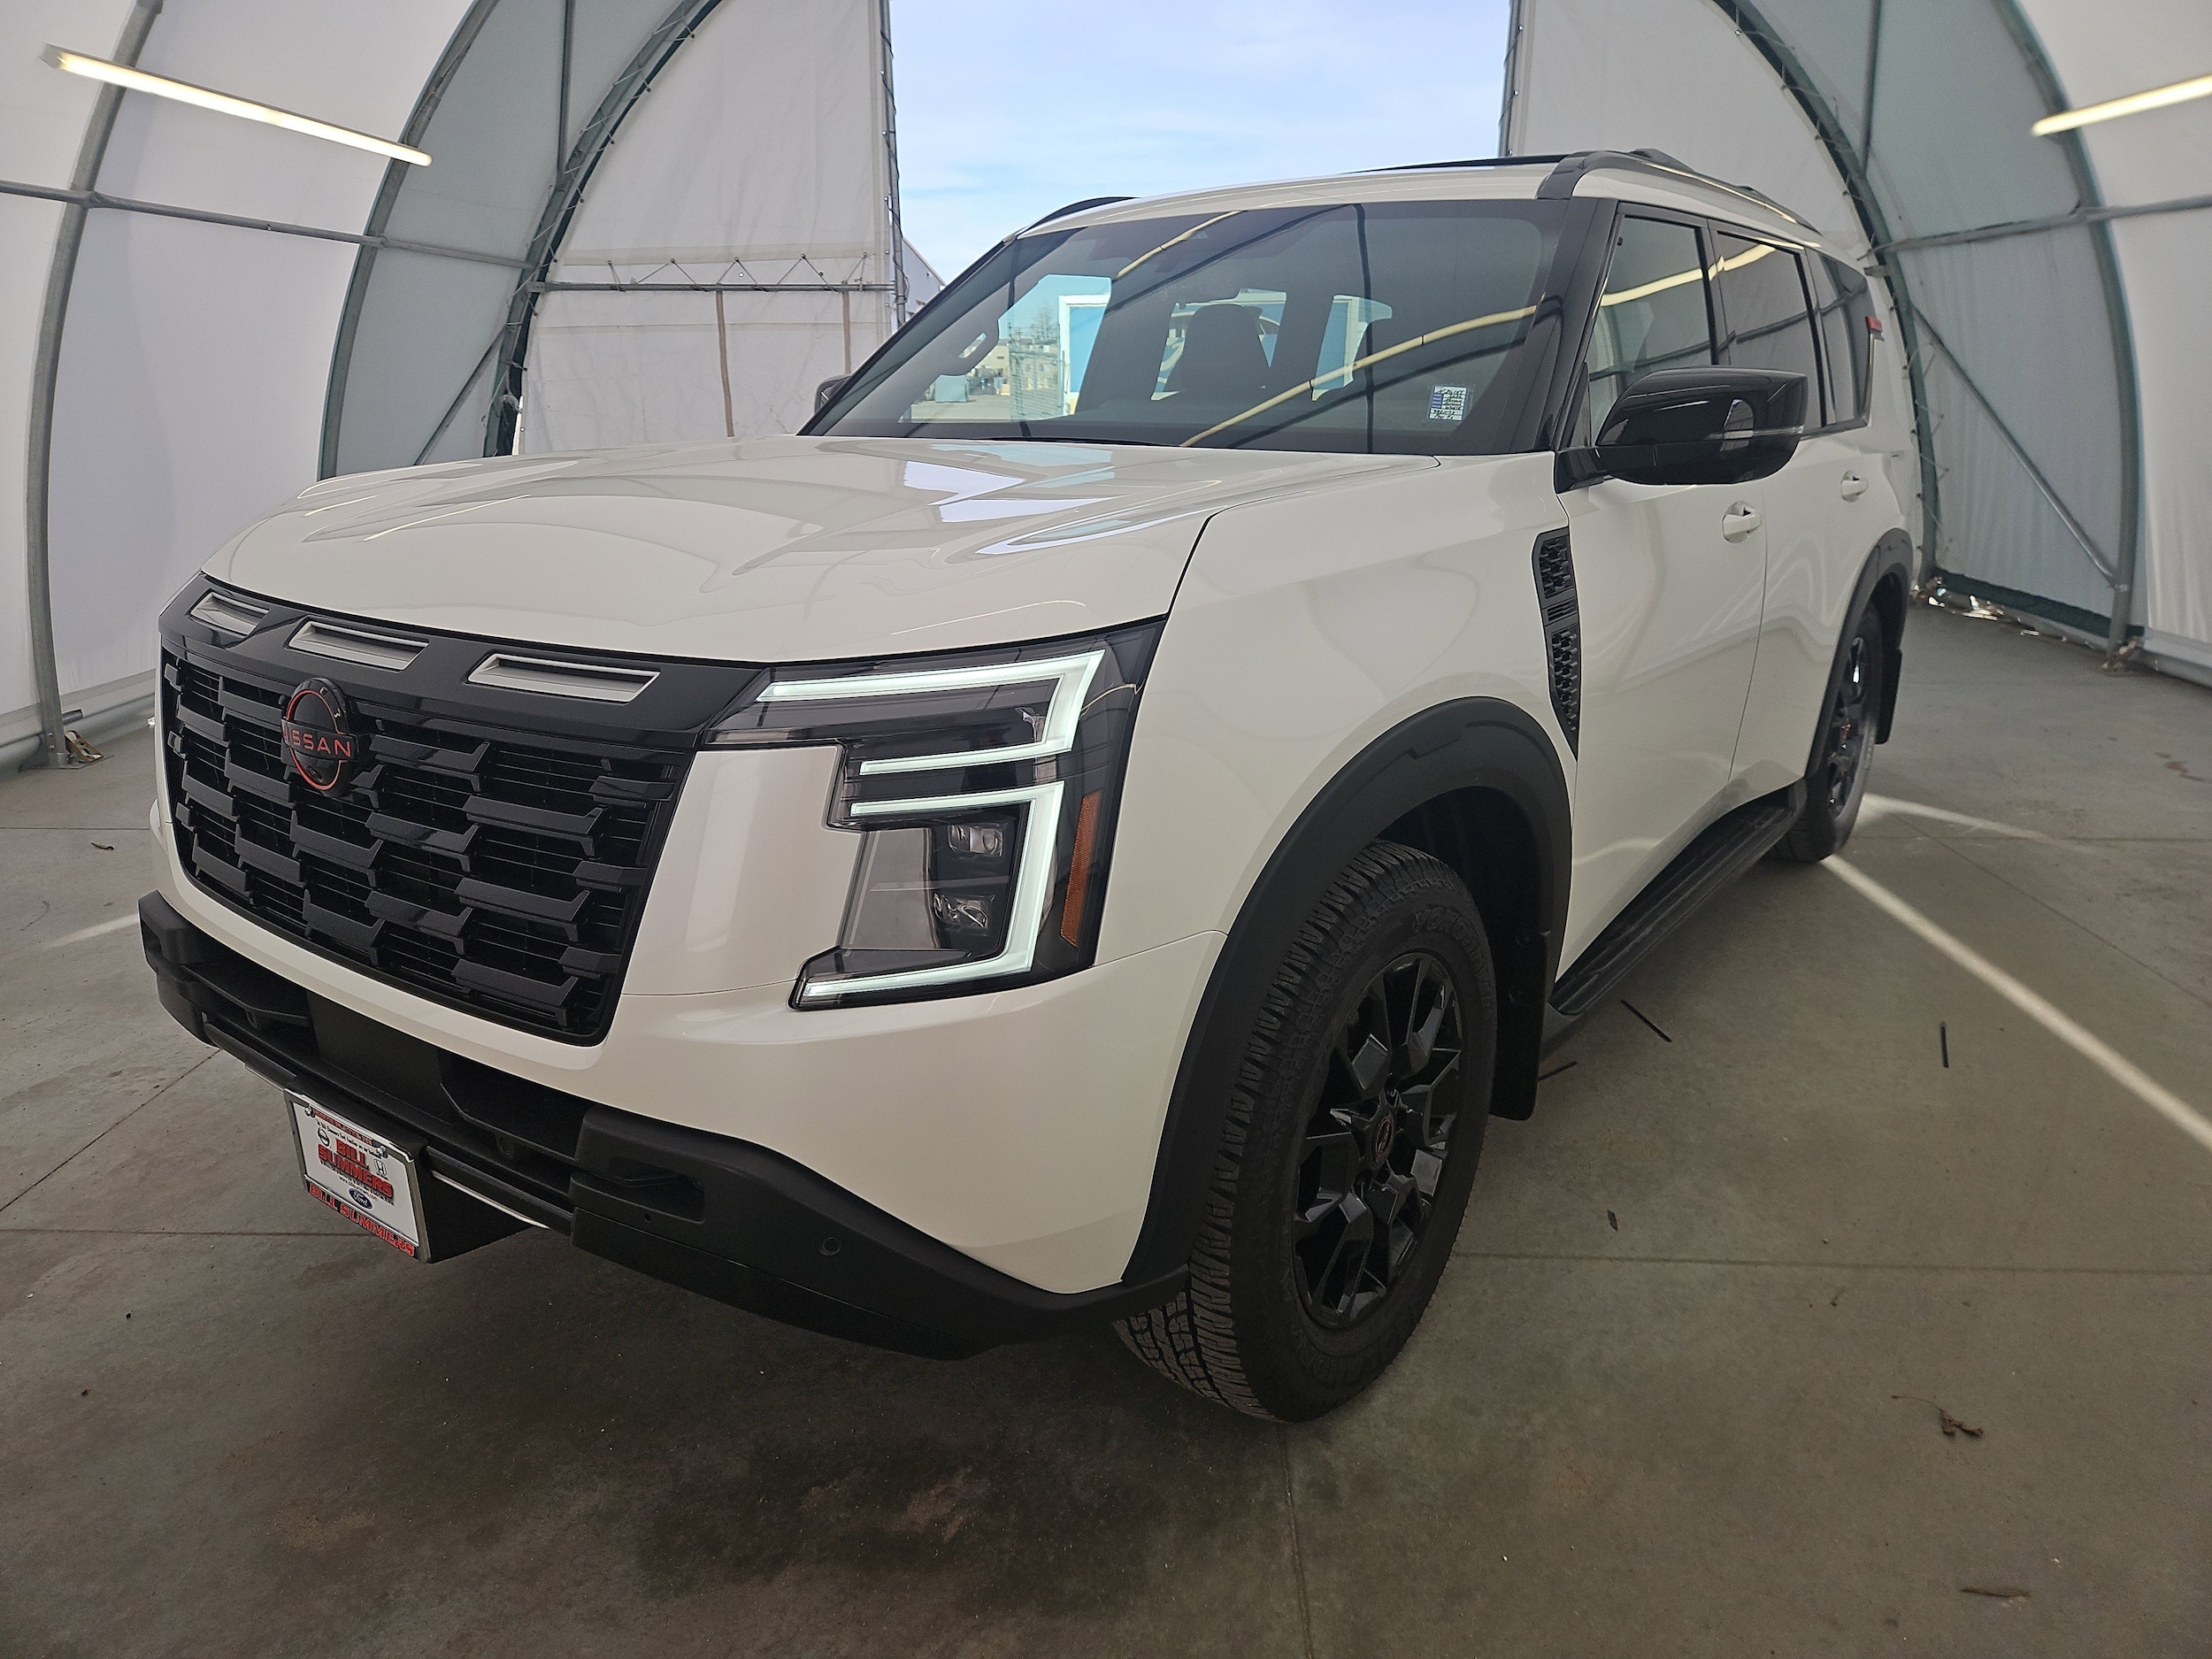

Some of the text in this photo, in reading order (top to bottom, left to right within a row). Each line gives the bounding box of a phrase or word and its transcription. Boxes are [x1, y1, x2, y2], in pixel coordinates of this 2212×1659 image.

[318, 1144, 393, 1199] SUMMERS
[336, 1138, 369, 1169] BILL
[310, 1182, 338, 1211] BILL
[340, 1202, 415, 1256] SUMMERS
